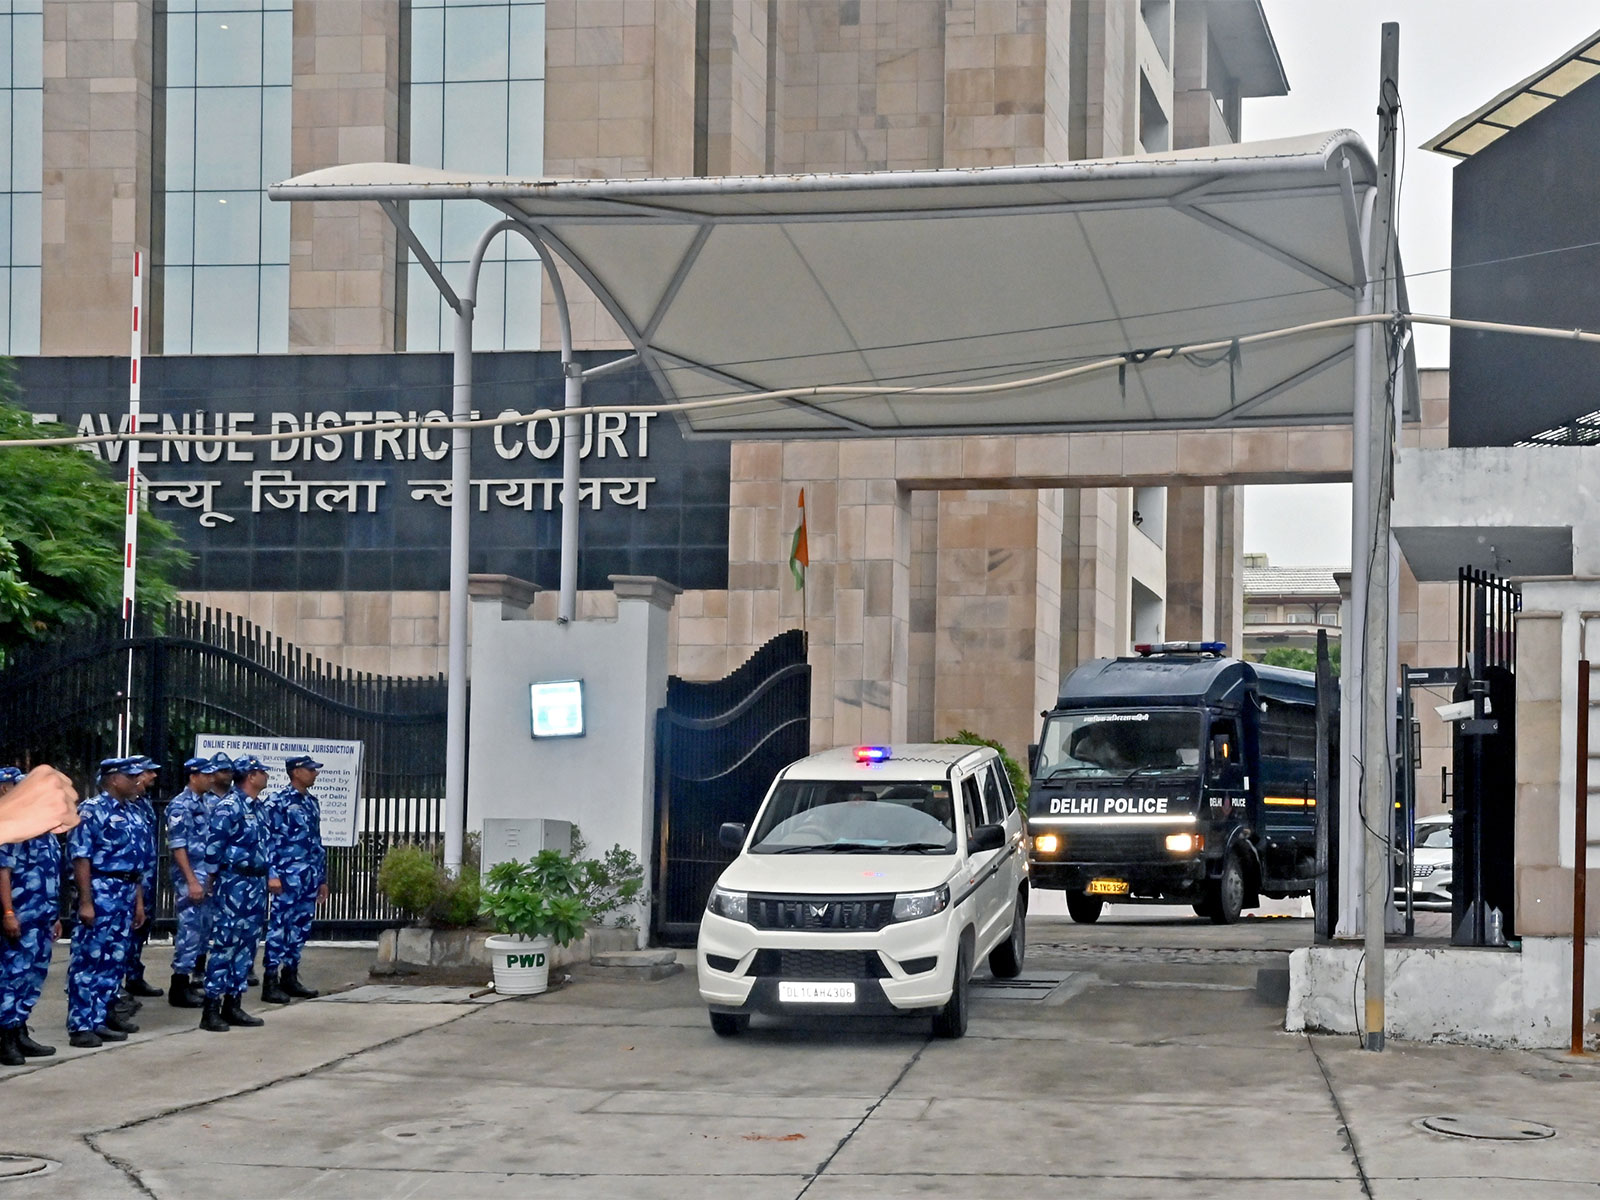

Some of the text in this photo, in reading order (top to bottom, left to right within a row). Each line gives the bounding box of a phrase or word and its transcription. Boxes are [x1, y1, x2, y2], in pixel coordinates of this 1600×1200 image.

[76, 412, 255, 462] AVENUE
[270, 410, 479, 462] DISTRIC
[244, 469, 386, 513] जिला
[203, 739, 355, 755] ONLINE FINE PAYMENT IN CRIMINAL JURISDICTION
[1049, 797, 1169, 814] DELHI POLICE
[1209, 797, 1246, 807] DELHI POLICE
[506, 953, 546, 968] PWD
